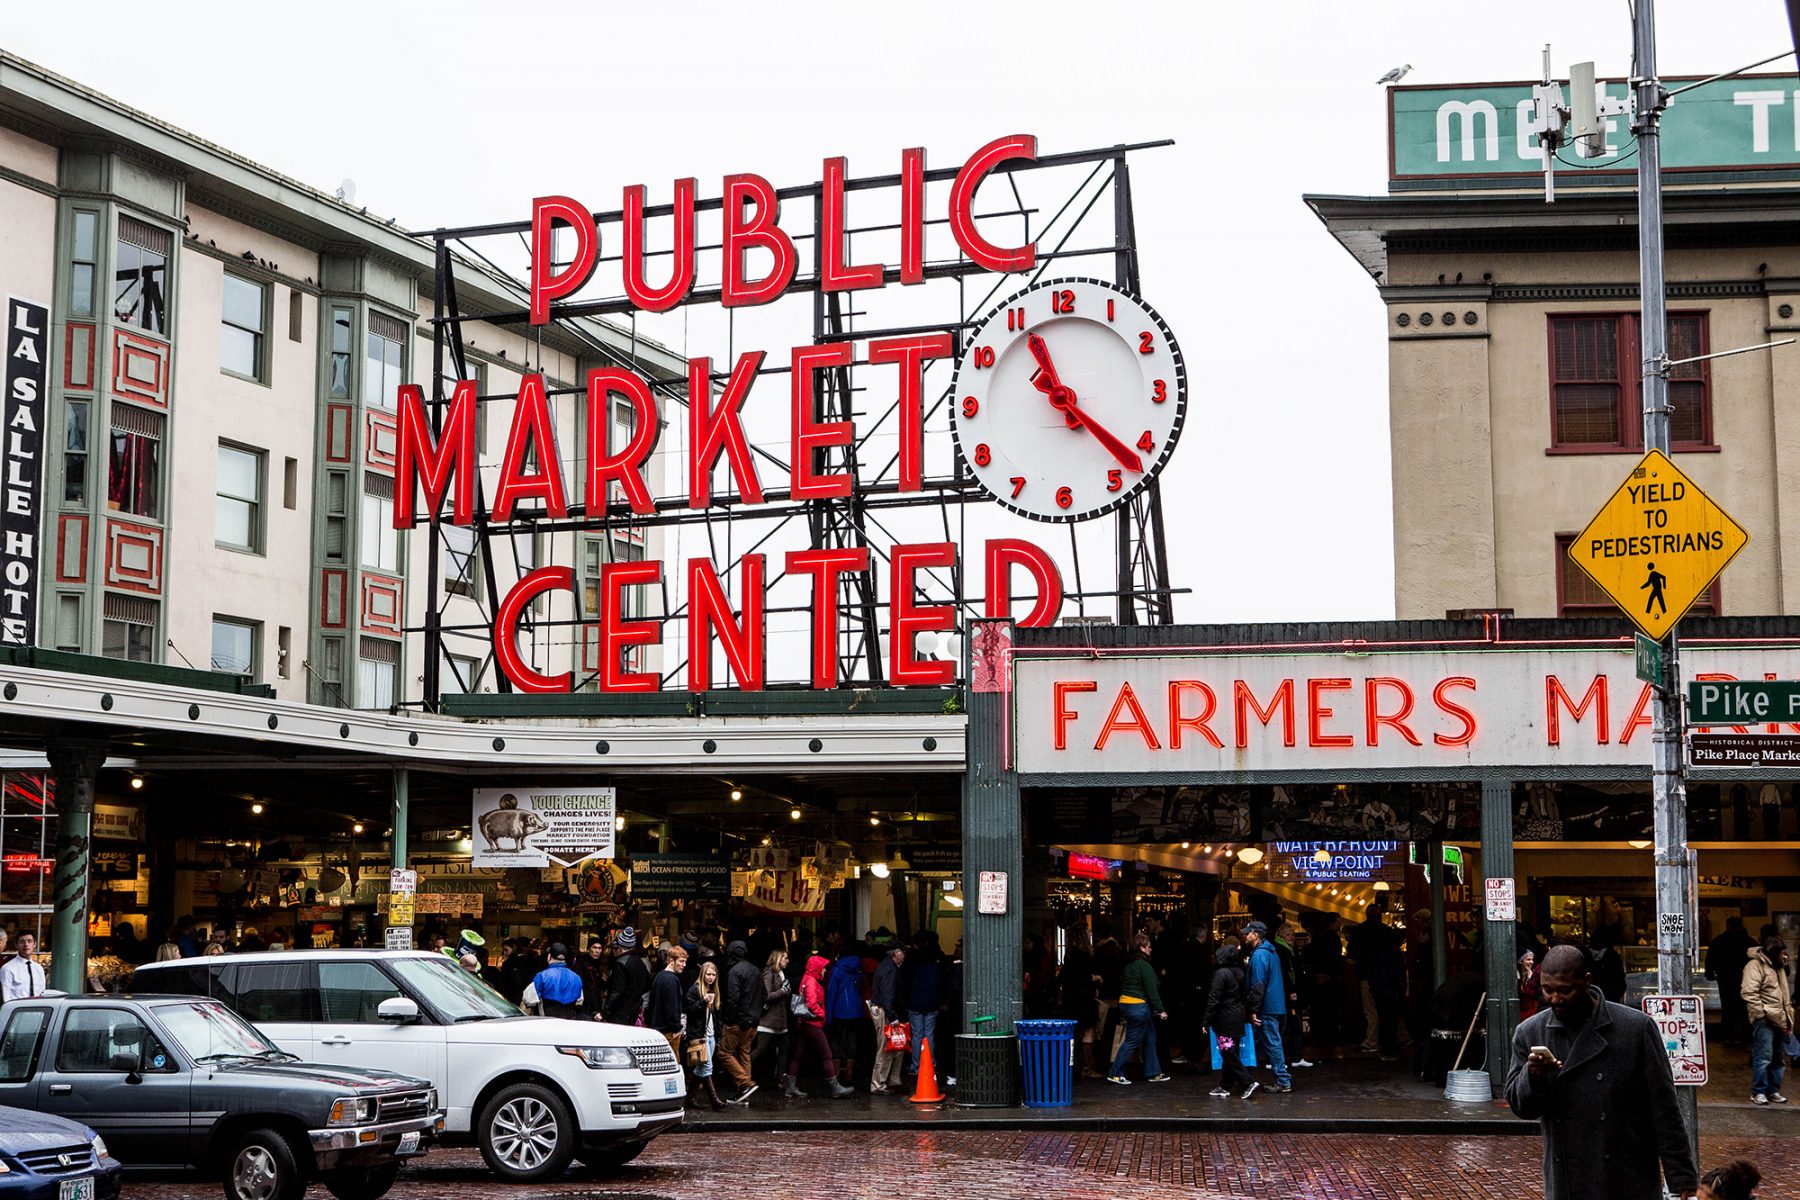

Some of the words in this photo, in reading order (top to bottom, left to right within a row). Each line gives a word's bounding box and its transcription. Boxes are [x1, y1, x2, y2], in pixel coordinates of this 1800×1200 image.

[1733, 90, 1800, 153] T
[530, 134, 1038, 325] PUBLIC
[1052, 290, 1075, 314] 12
[1107, 299, 1114, 322] 1
[1008, 307, 1024, 331] 11
[13, 305, 40, 364] LA
[1138, 331, 1154, 354] 2
[974, 346, 995, 369] 10
[1151, 379, 1166, 403] 3
[962, 396, 979, 418] 9
[393, 333, 952, 530] MARKET
[1136, 430, 1155, 454] 4
[6, 377, 37, 517] SALLE
[975, 443, 991, 467] 8
[1009, 476, 1027, 499] 7
[1106, 469, 1123, 492] 5
[1055, 486, 1073, 509] 6
[1627, 482, 1685, 505] YIELD
[1643, 509, 1668, 529] TO
[1591, 530, 1723, 559] PEDESTRIANS
[1701, 685, 1770, 716] Pike
[1054, 677, 1477, 750] FARMERS
[1695, 749, 1723, 760] Pike
[1725, 749, 1760, 760] Place
[531, 795, 564, 810] YOUR
[564, 795, 611, 810] CHANGE
[1292, 855, 1384, 869] VIEWPOINT
[1488, 880, 1499, 888] NO
[1661, 913, 1684, 925] SHOE
